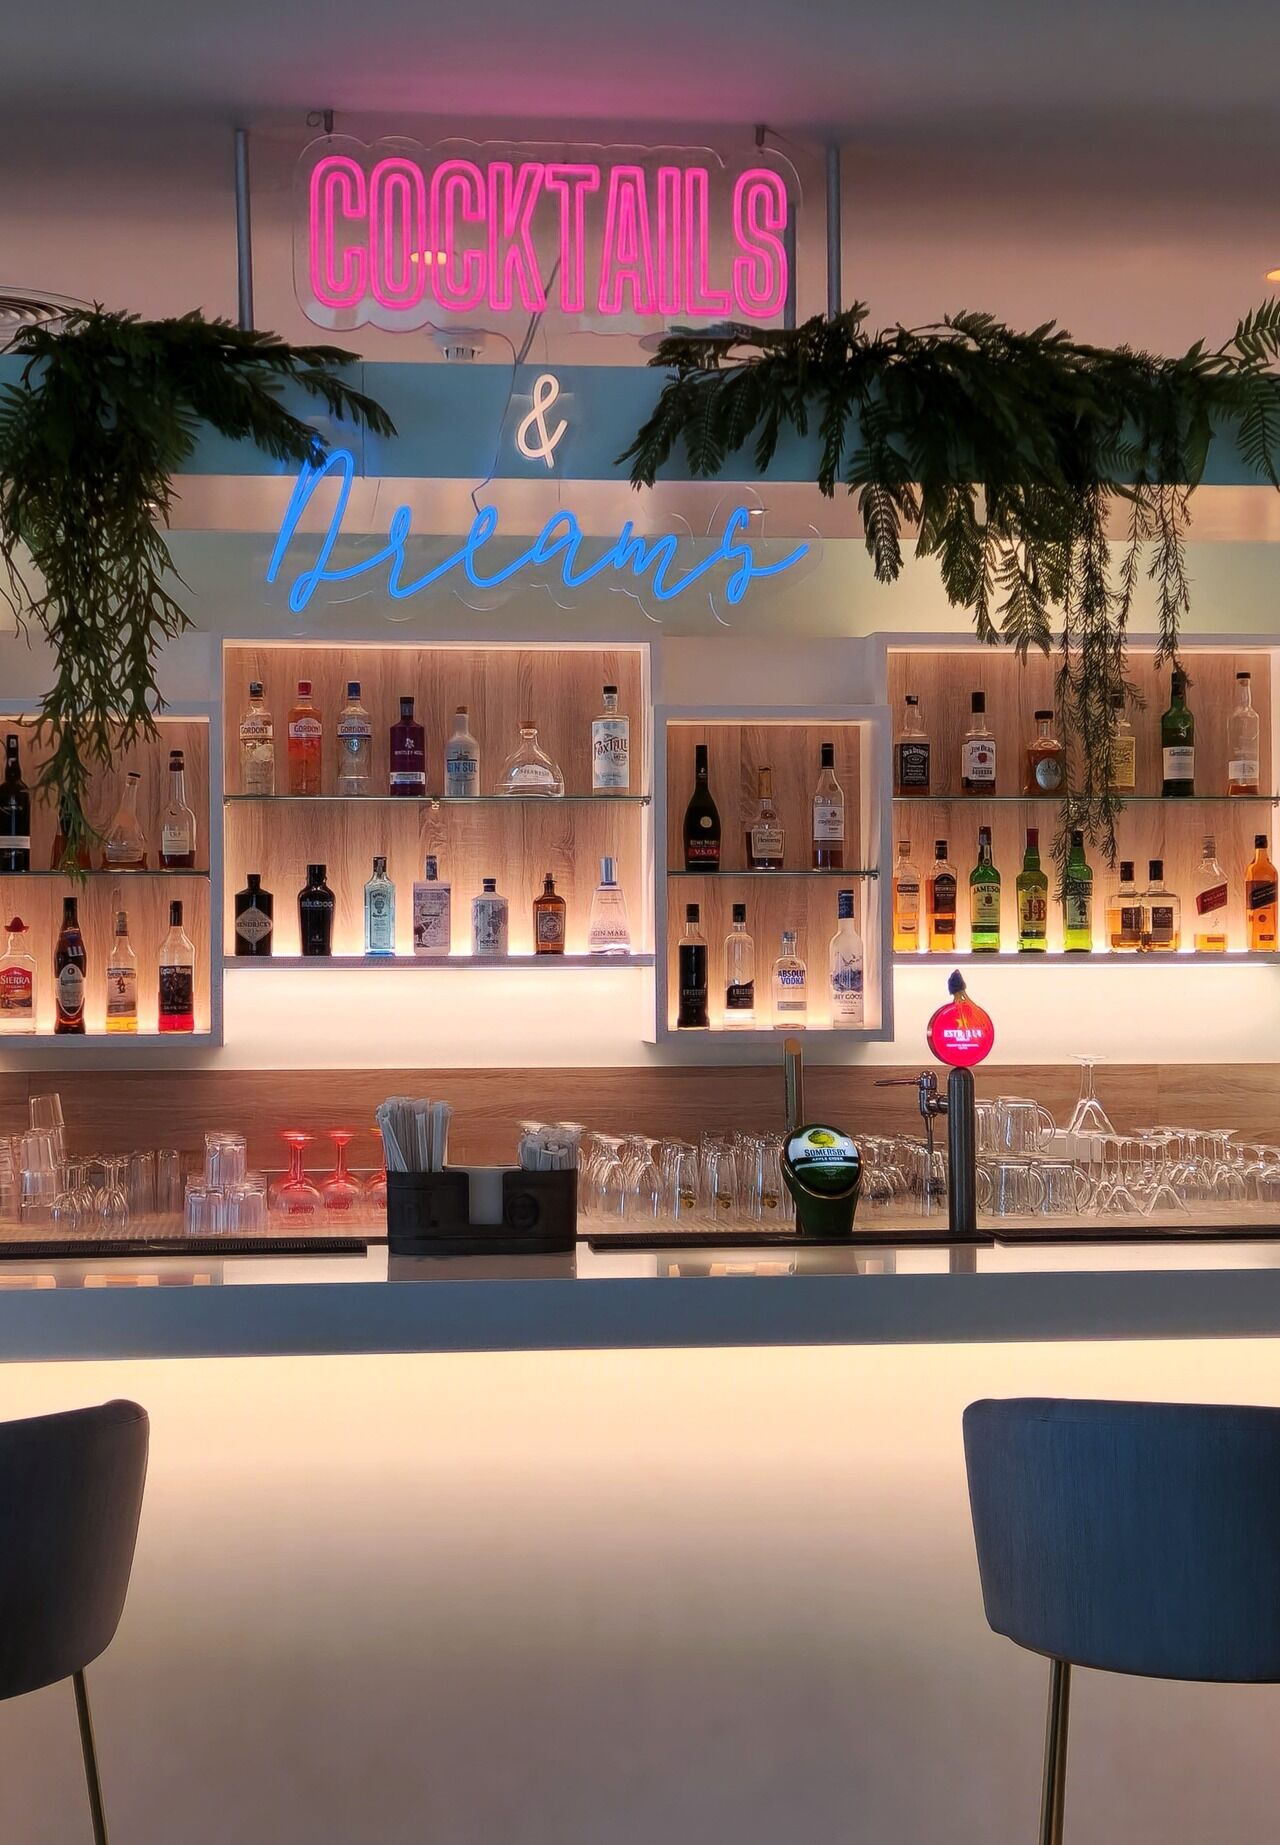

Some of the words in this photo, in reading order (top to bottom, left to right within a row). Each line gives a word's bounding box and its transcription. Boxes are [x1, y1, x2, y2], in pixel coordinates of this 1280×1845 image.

[309, 155, 789, 319] COCKTAILS
[515, 374, 568, 468] &
[266, 440, 811, 613] Dreams
[302, 900, 334, 909] BULLDOG
[0, 974, 31, 985] SIERRA
[781, 977, 804, 985] VODKA
[804, 1148, 847, 1157] SOMERSBY
